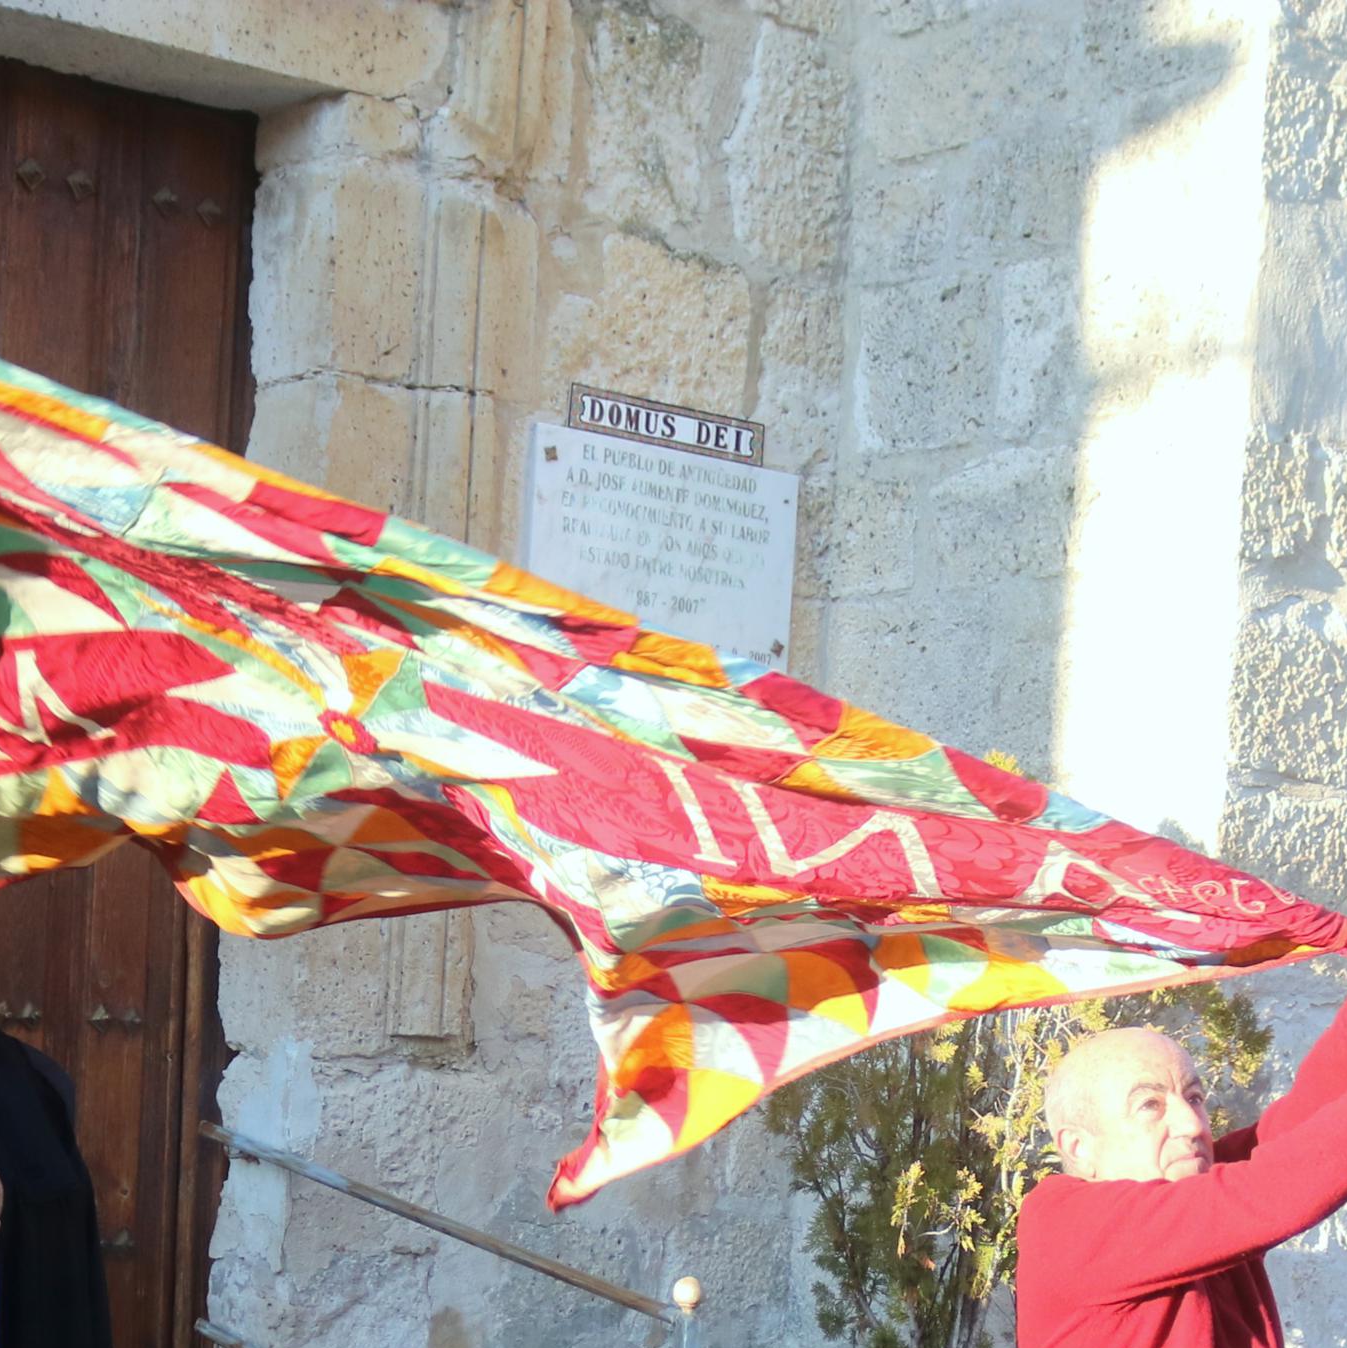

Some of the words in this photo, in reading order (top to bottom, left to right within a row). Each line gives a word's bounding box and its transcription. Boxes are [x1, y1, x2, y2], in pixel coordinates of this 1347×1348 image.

[589, 399, 676, 438] DOMUS
[696, 420, 743, 452] DEI
[566, 466, 575, 483] A
[583, 443, 599, 462] EL
[603, 447, 653, 472] PUEBLO
[658, 458, 675, 478] DE
[699, 517, 707, 533] A
[732, 524, 771, 545] LABOR
[579, 544, 631, 570] ESTADO
[635, 554, 674, 578] ENTRE
